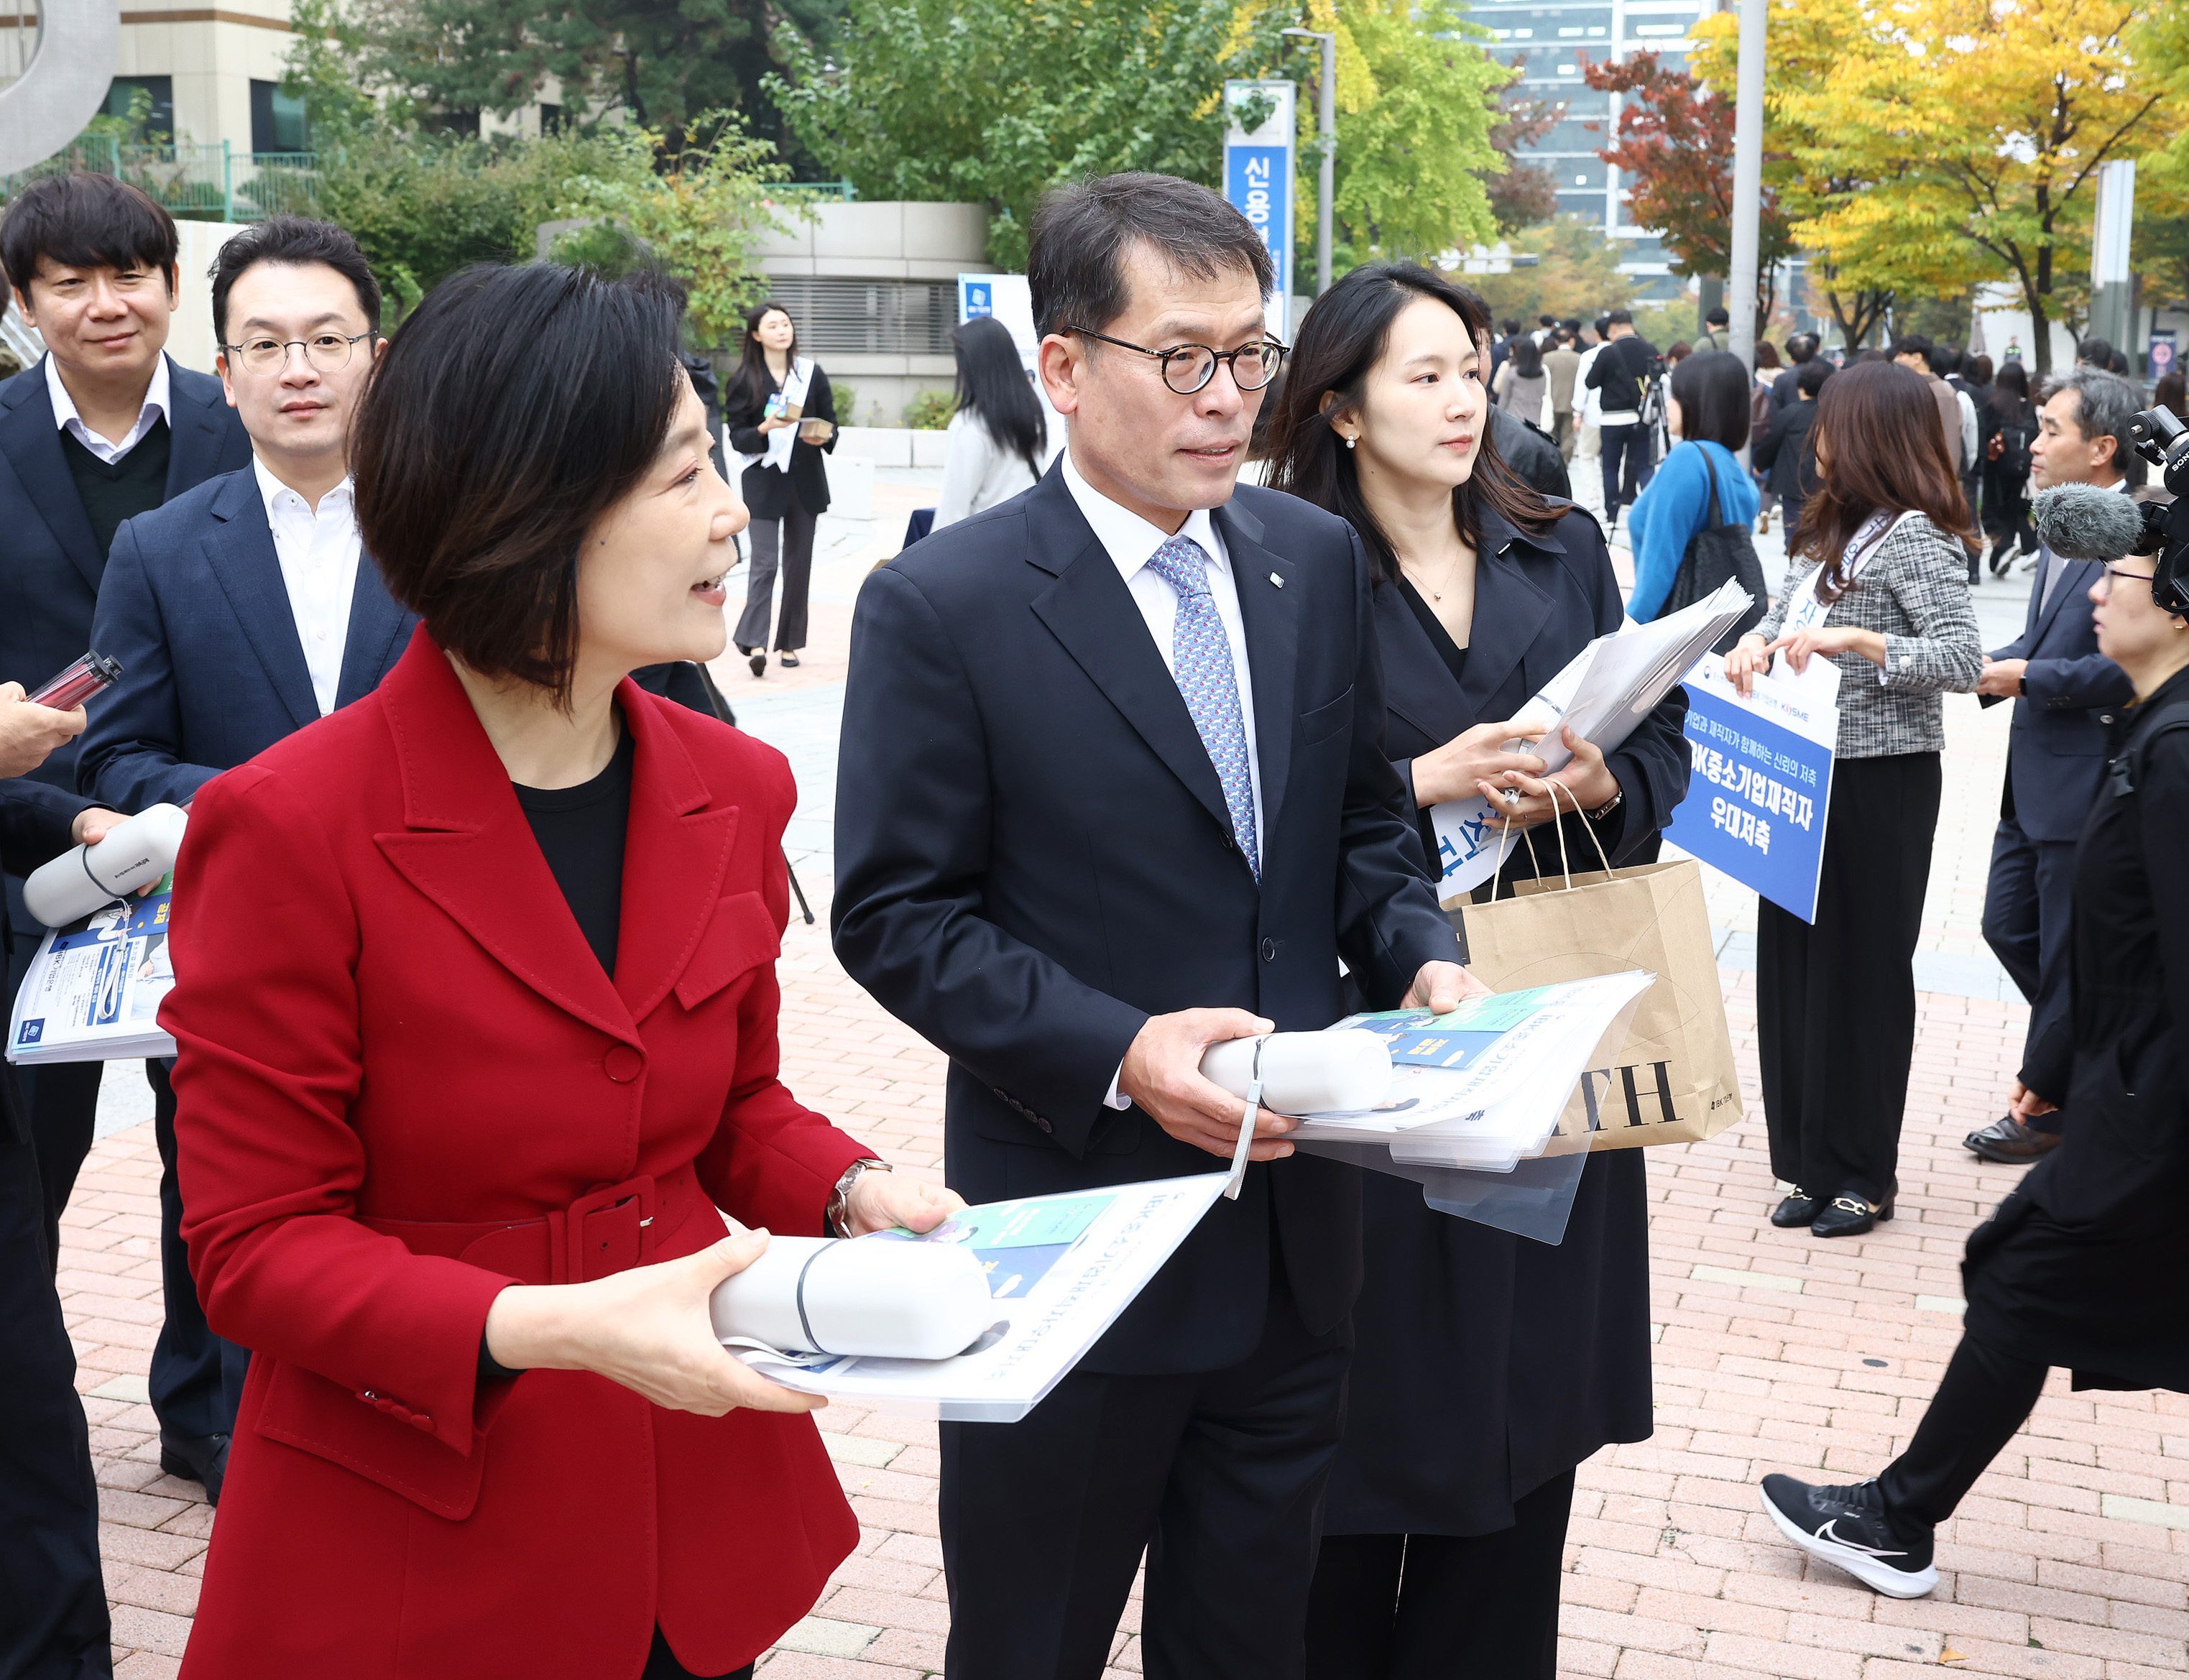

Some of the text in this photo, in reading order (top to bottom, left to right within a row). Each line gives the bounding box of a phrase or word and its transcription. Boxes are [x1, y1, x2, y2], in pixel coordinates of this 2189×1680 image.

[1244, 156, 1271, 243] 신용
[1685, 737, 1814, 832] BK중소기업재직자
[1708, 719, 1740, 749] 재직자가
[1741, 735, 1773, 766] 함께하는
[1774, 752, 1799, 778] 신뢰의
[1799, 763, 1817, 788] 저축
[1710, 796, 1771, 856] 우대저축
[1551, 1061, 1685, 1136] TH
